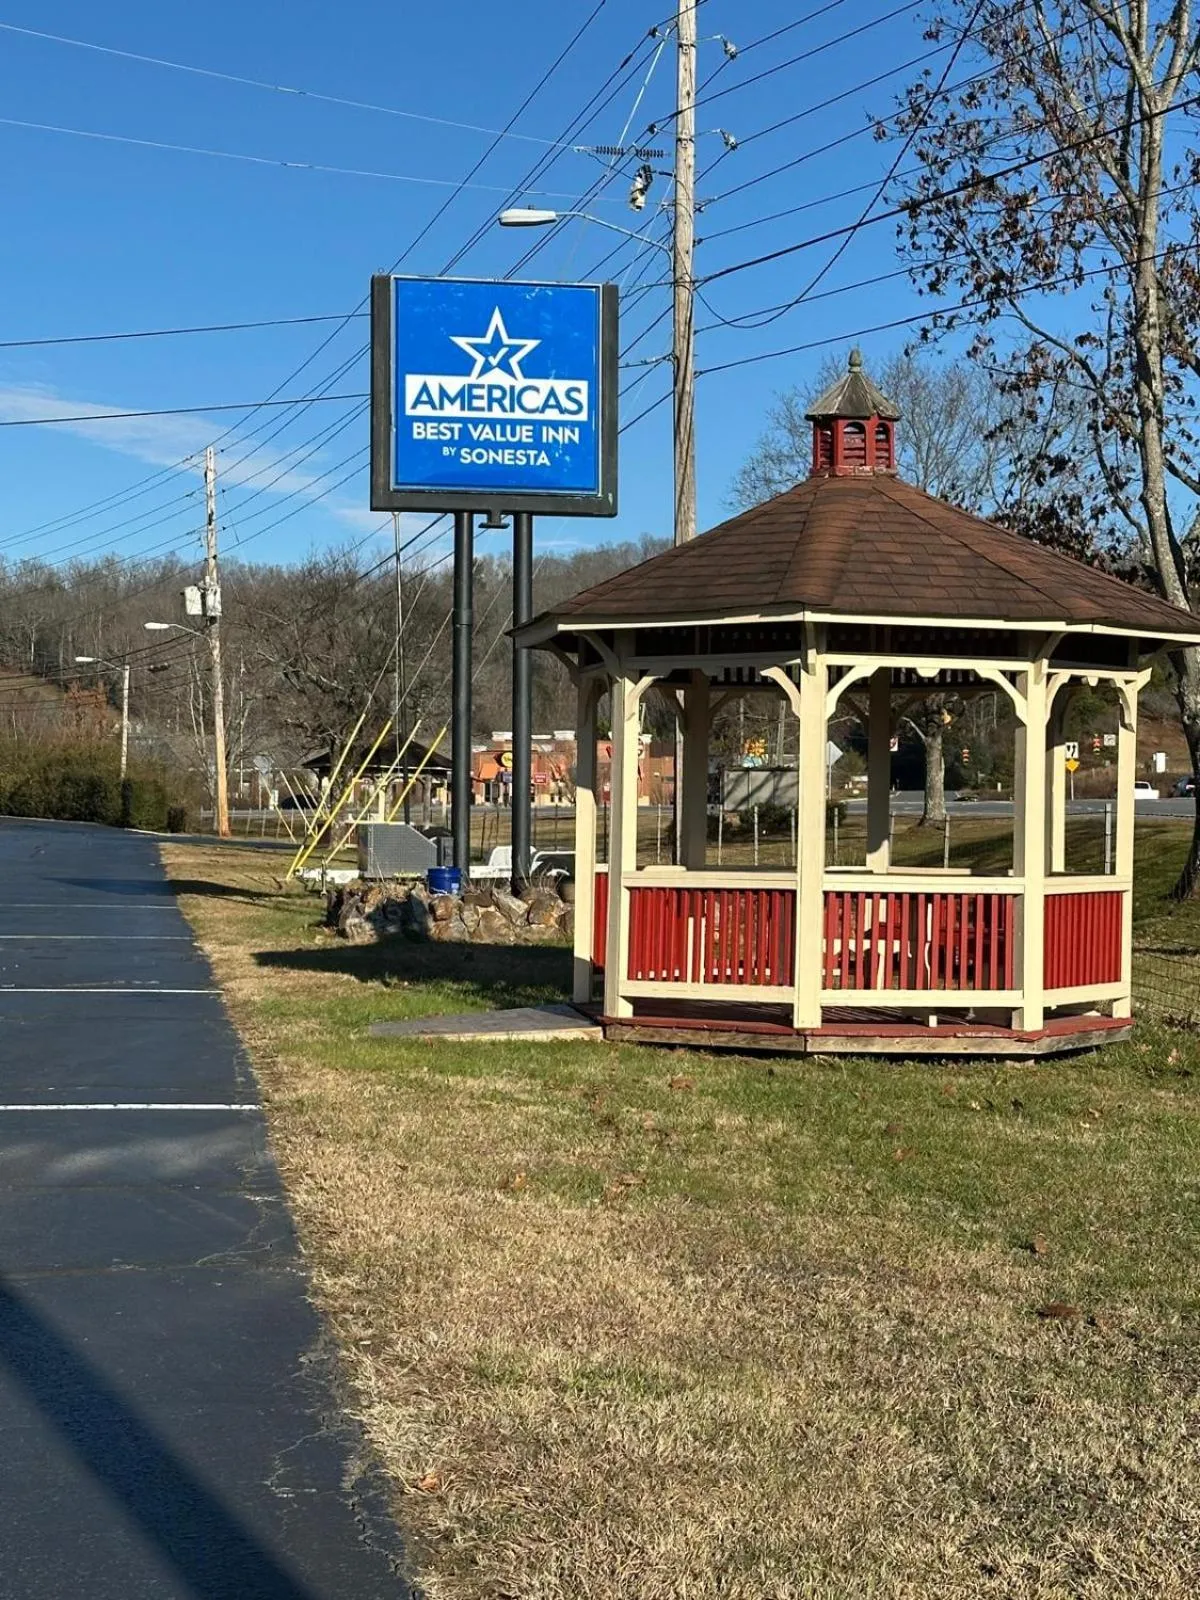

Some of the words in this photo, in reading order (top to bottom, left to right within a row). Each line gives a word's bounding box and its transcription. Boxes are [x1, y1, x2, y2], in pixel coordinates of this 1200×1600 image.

[410, 381, 584, 415] AMERICAS
[412, 422, 463, 441] BEST
[468, 424, 533, 443] VALUE
[542, 426, 579, 444] INN
[442, 446, 457, 457] BY
[460, 448, 550, 466] SONESTA
